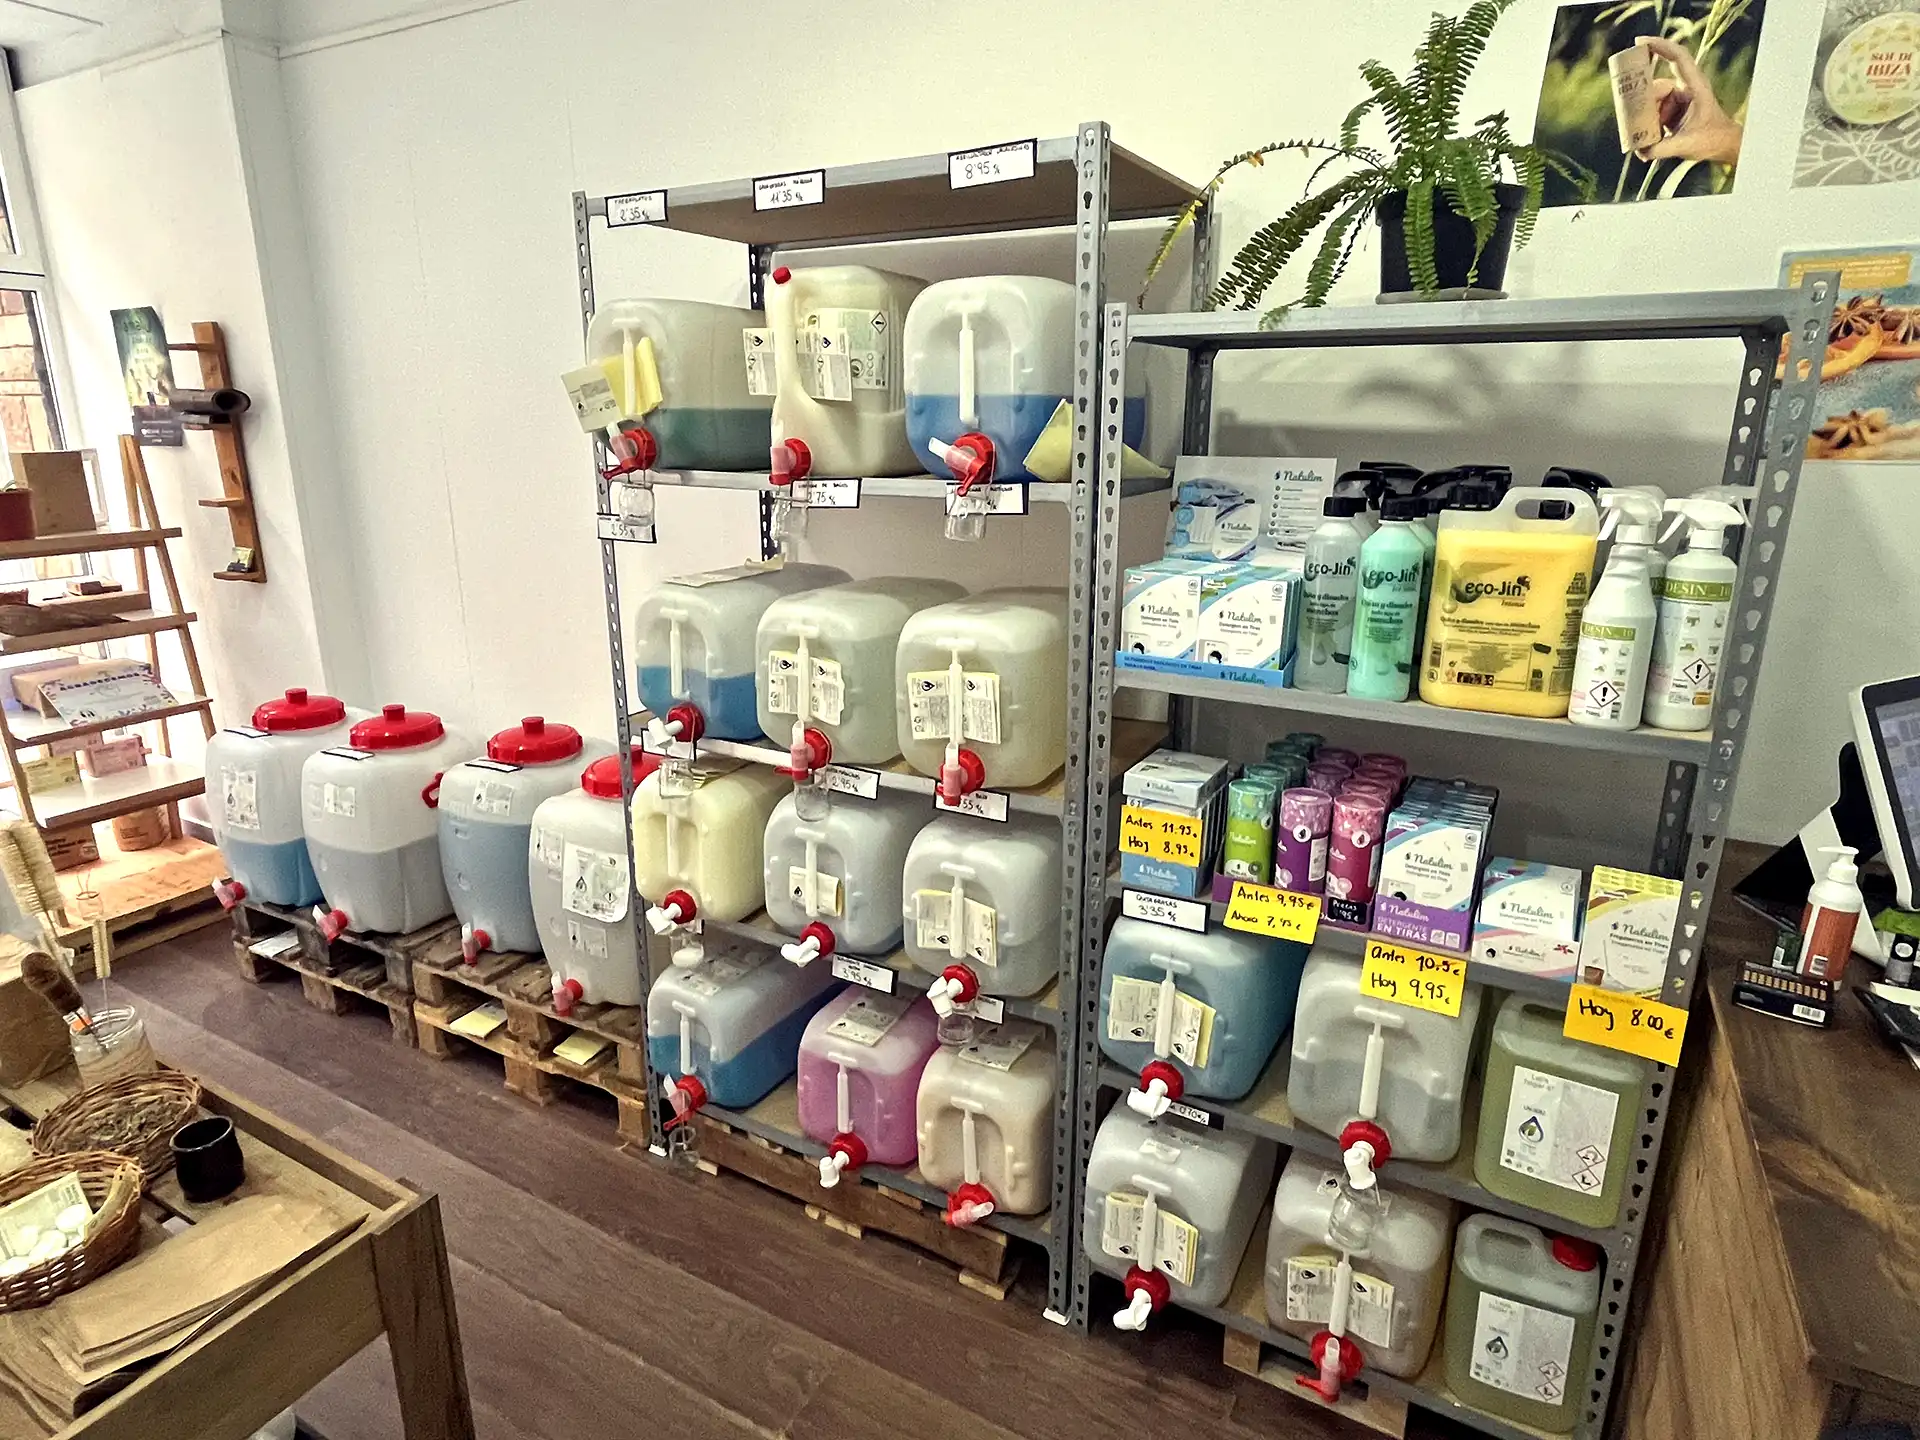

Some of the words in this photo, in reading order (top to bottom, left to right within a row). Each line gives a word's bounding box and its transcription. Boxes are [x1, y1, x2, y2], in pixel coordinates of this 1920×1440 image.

[1866, 63, 1910, 76] IBIZA
[1283, 470, 1323, 482] Natulim
[1308, 561, 1351, 576] eco-Jin
[1369, 568, 1416, 583] eco-Jin
[1465, 581, 1522, 597] eco-Jin
[1667, 582, 1706, 596] DESIN
[1147, 604, 1180, 617] Natulim
[1227, 610, 1262, 624] Natulim
[1229, 671, 1266, 685] Natulim
[1126, 814, 1153, 830] Antes
[1128, 835, 1149, 853] Hoy
[1413, 853, 1454, 870] Natulim
[1237, 886, 1270, 903] Antes
[1388, 903, 1430, 922] Natulim
[1509, 902, 1554, 919] Natulim
[1377, 922, 1392, 935] EN
[1395, 927, 1428, 942] TIRAS
[1622, 923, 1670, 941] Natulim
[1371, 972, 1397, 997] Hoy
[1579, 998, 1615, 1031] Hoy
